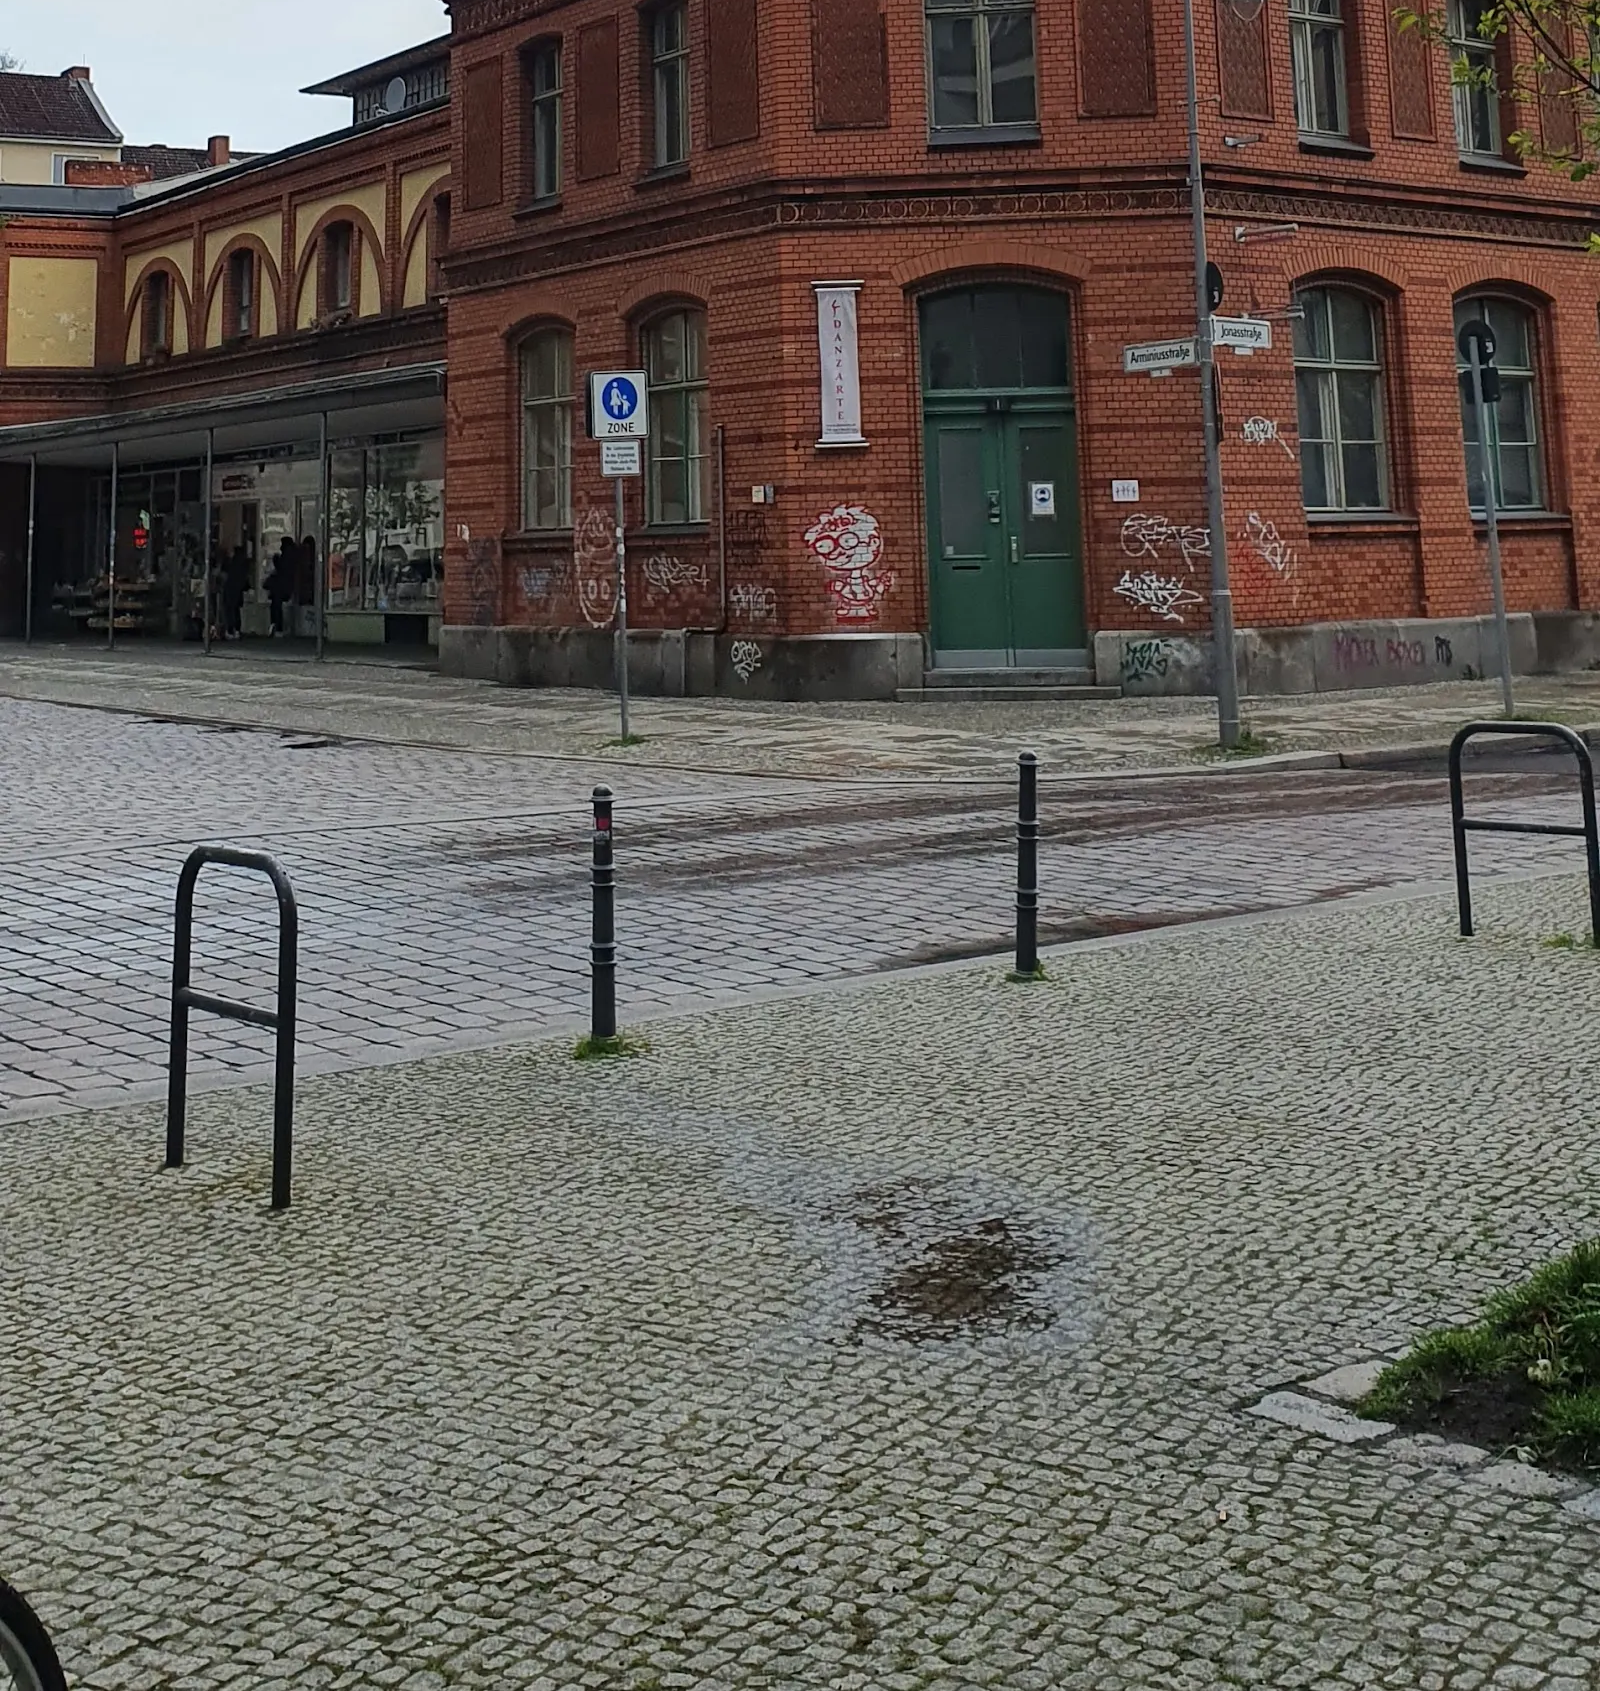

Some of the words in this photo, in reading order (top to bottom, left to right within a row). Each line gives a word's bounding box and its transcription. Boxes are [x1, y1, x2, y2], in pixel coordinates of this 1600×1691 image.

[1221, 323, 1262, 342] Jonasstraße
[1130, 346, 1190, 364] Arminiusstraße
[832, 319, 845, 421] DANZARTE
[607, 422, 635, 433] ZONE
